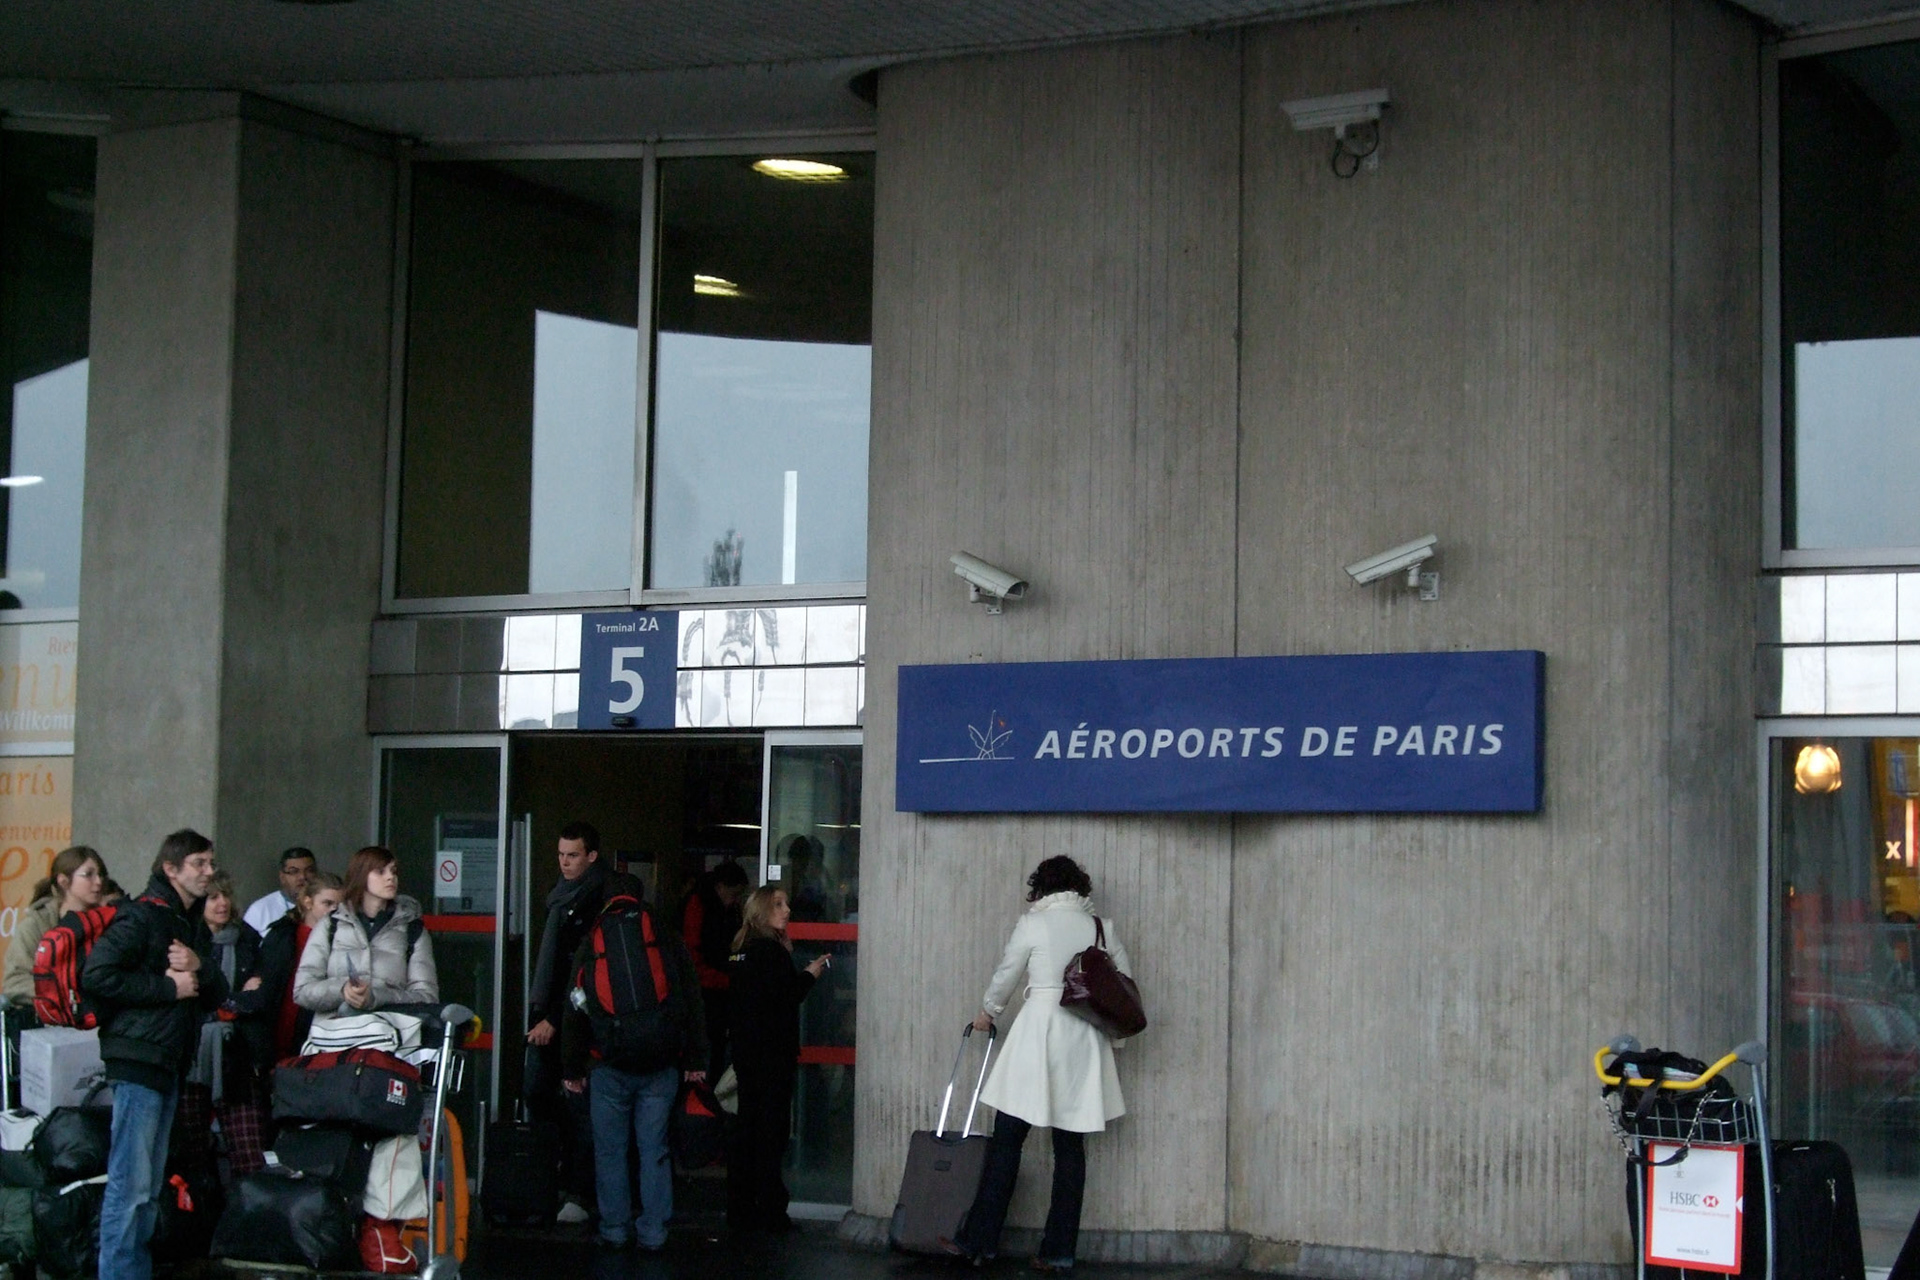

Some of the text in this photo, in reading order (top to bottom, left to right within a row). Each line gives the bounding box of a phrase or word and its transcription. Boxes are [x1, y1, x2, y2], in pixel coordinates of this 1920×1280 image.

[596, 617, 660, 633] Terminal 2A
[0, 663, 77, 709] nu
[608, 646, 645, 714] 5
[1034, 722, 1504, 760] AÉROPORTS DE PARIS
[1670, 1191, 1700, 1207] HSBC
